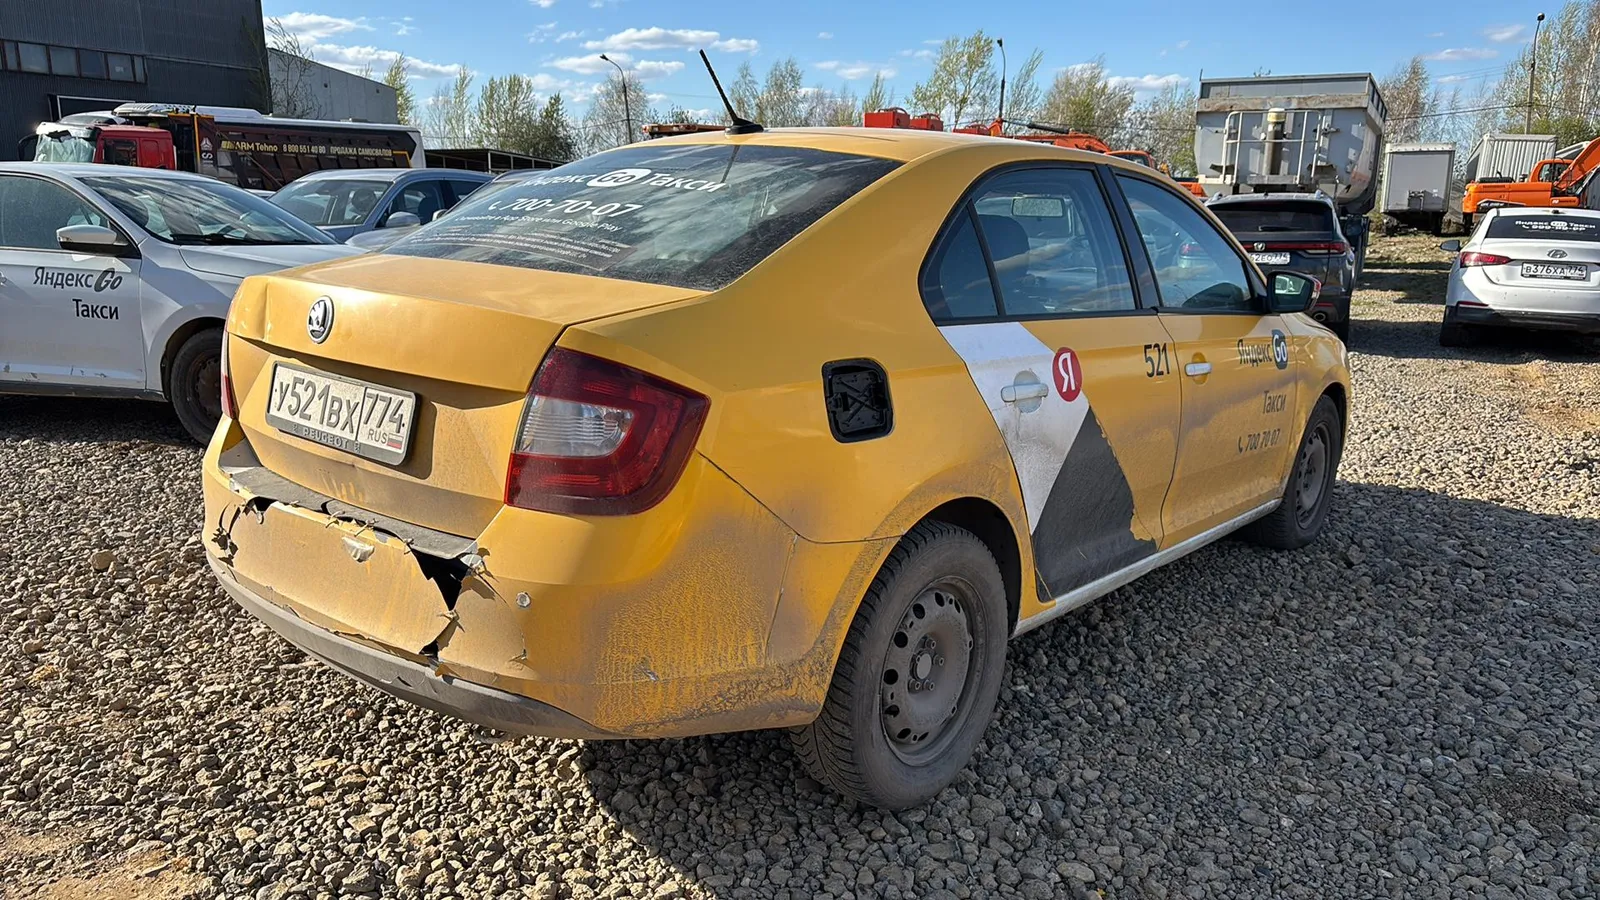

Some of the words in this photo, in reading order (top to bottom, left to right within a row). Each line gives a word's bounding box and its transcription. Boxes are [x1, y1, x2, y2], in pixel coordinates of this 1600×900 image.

[255, 142, 279, 152] Tehno
[282, 144, 288, 152] 8
[640, 173, 727, 192] Такси
[503, 198, 643, 217] 700-70-07
[562, 218, 598, 228] Google
[33, 266, 93, 290] Яндекс
[94, 268, 123, 292] Go
[1525, 263, 1566, 275] В376ХА
[1567, 265, 1584, 273] 774
[72, 298, 119, 320] Такси
[1143, 342, 1170, 378] 521
[1237, 338, 1273, 368] Яндекс
[1272, 333, 1288, 363] Go
[1058, 352, 1076, 393] Я
[276, 376, 360, 434] У521ВХ
[363, 391, 405, 434] 774
[1262, 389, 1287, 414] Такси
[302, 427, 349, 449] PEUGEOT
[367, 428, 388, 445] RUS
[1245, 432, 1260, 452] 700
[1260, 430, 1270, 448] 70
[1269, 428, 1281, 447] 07
